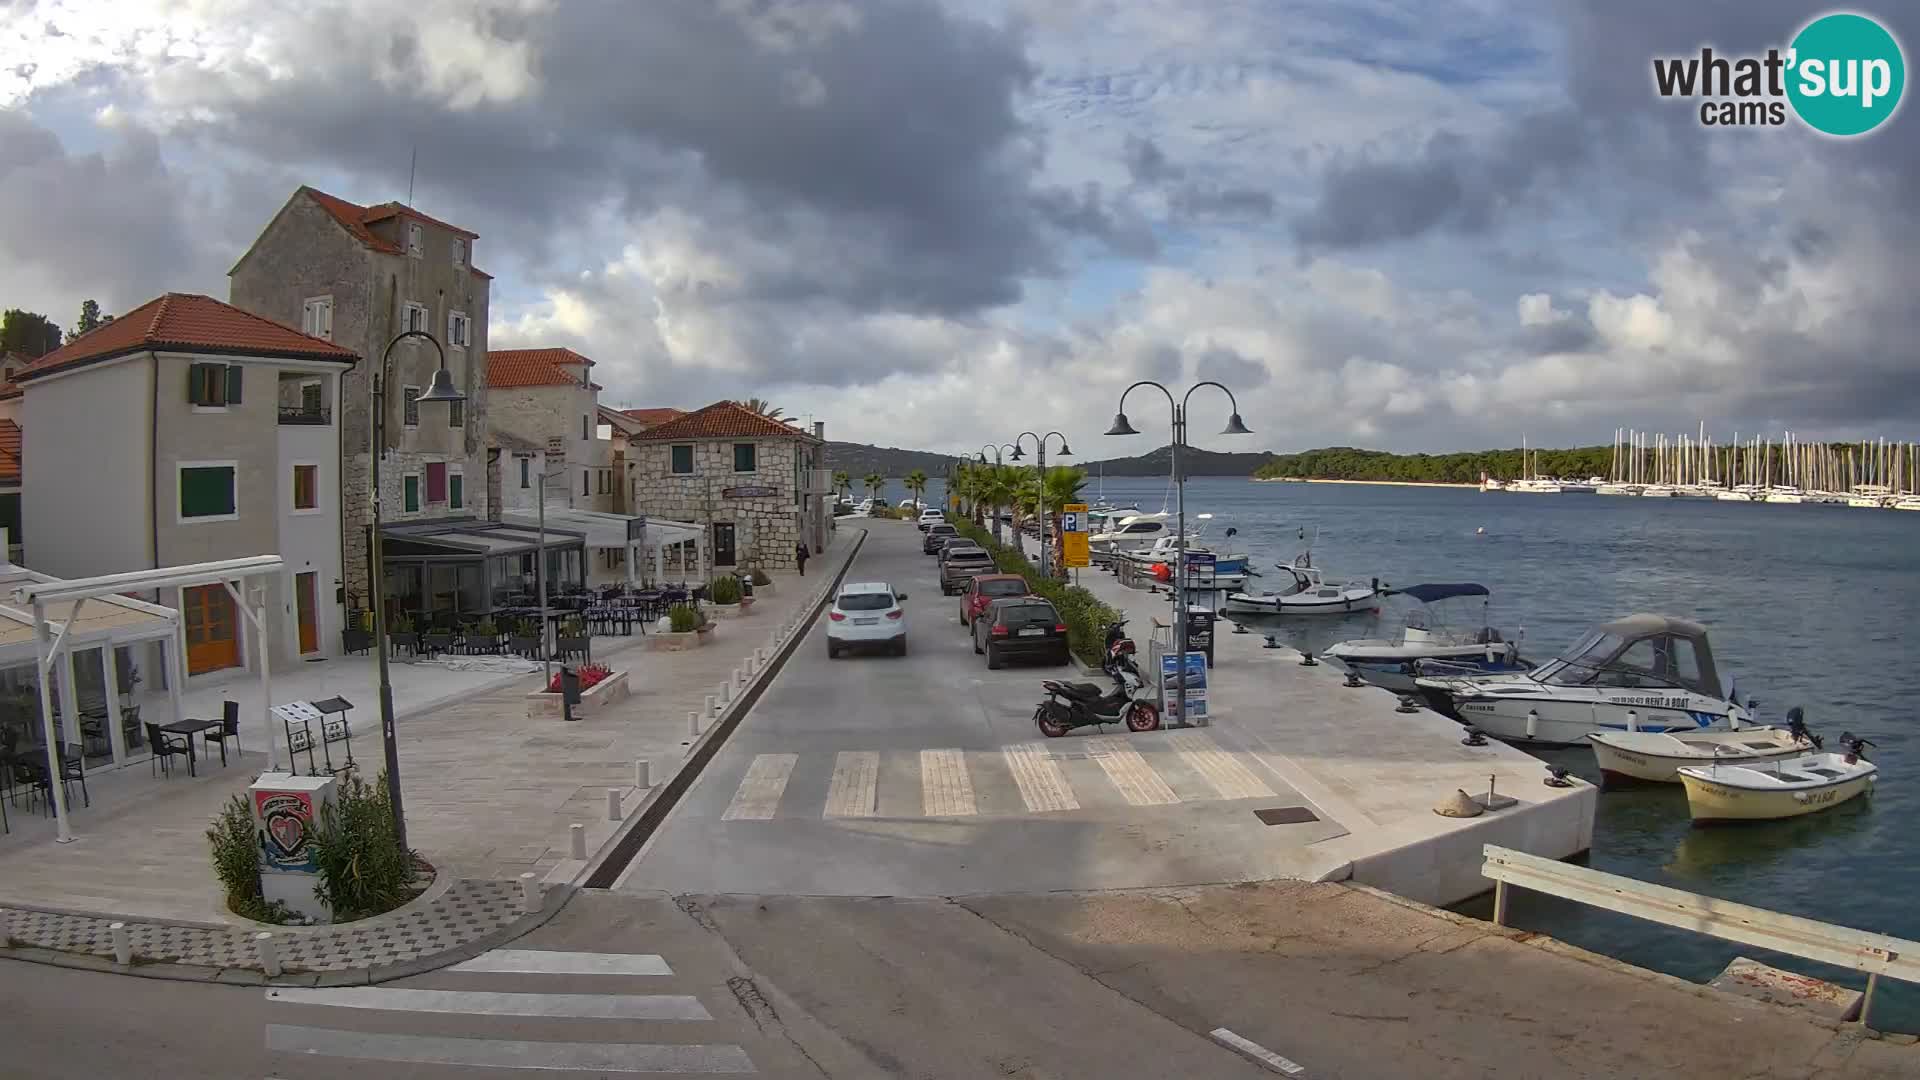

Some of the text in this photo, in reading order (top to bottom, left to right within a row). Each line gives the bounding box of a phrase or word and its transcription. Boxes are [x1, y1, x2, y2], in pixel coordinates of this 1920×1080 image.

[1065, 514, 1076, 530] P
[1645, 696, 1664, 707] RENT
[1665, 697, 1670, 707] A
[1671, 697, 1690, 709] BOAT
